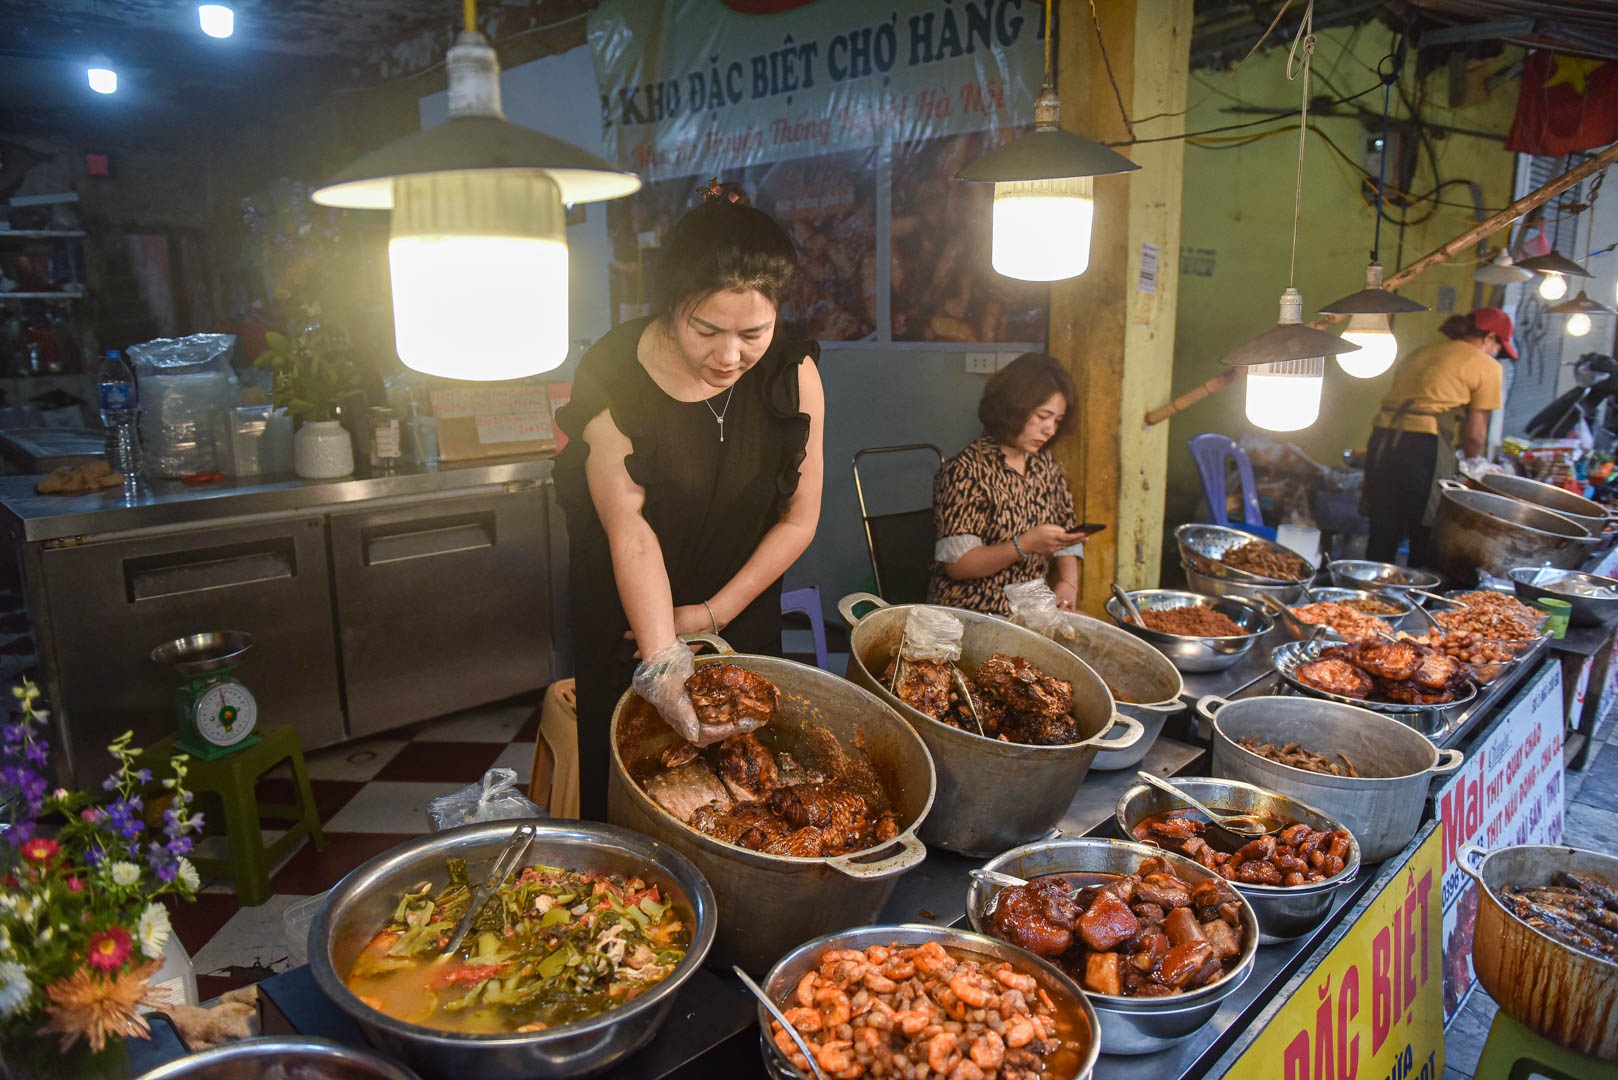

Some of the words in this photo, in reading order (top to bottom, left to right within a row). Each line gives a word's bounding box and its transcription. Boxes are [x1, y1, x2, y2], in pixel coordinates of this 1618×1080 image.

[618, 77, 681, 125] KHO
[687, 54, 743, 121] ĐẶC
[751, 33, 818, 106] BIỆT
[827, 12, 897, 87] CHỢ
[1441, 752, 1485, 876] Mai
[1486, 770, 1504, 809] THỊT
[1505, 744, 1524, 784] QUAY
[1486, 811, 1503, 849] THỊT
[1442, 867, 1460, 908] 0396
[1372, 868, 1433, 1058] BIỆT
